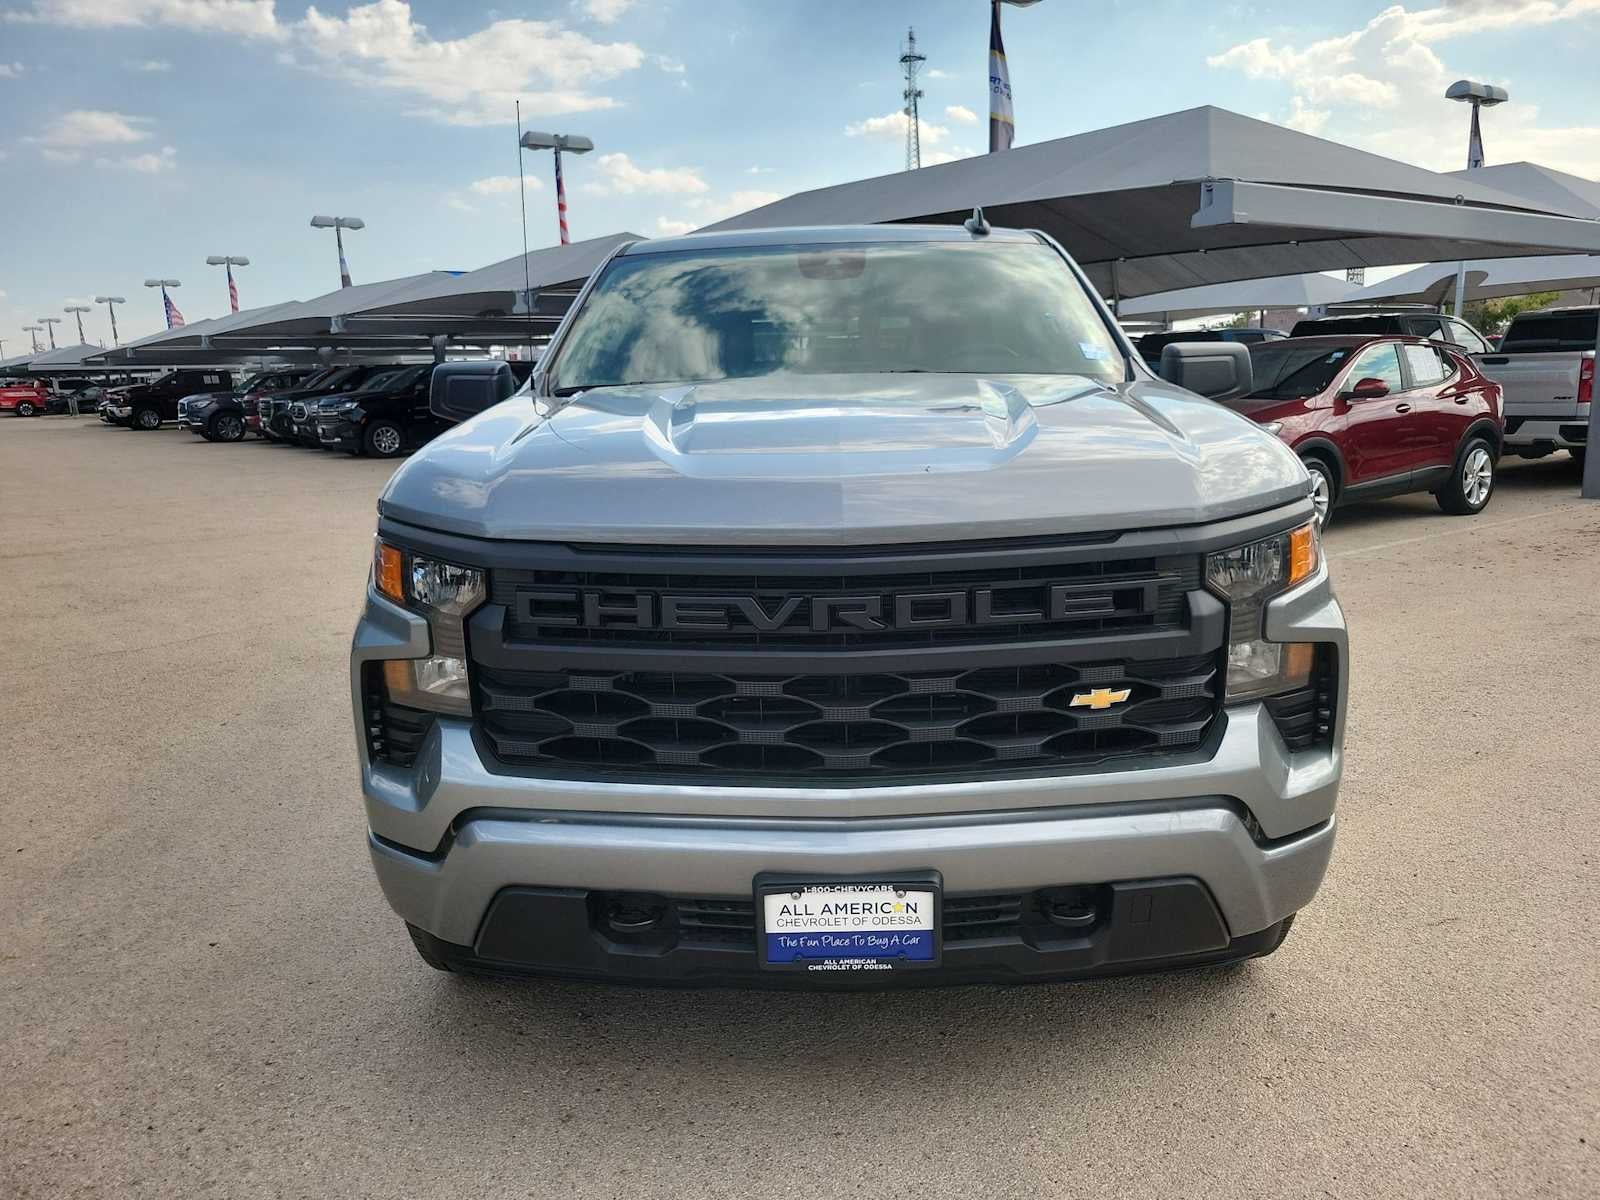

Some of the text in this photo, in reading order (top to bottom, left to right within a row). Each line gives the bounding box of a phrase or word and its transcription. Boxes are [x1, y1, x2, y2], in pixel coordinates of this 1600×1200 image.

[516, 578, 1181, 631] CHEVROLET
[779, 902, 918, 916] ALL AMERICN
[776, 916, 922, 928] CHEVROLET OF ODESSA
[778, 934, 921, 949] The Fun Place To Buy A Car
